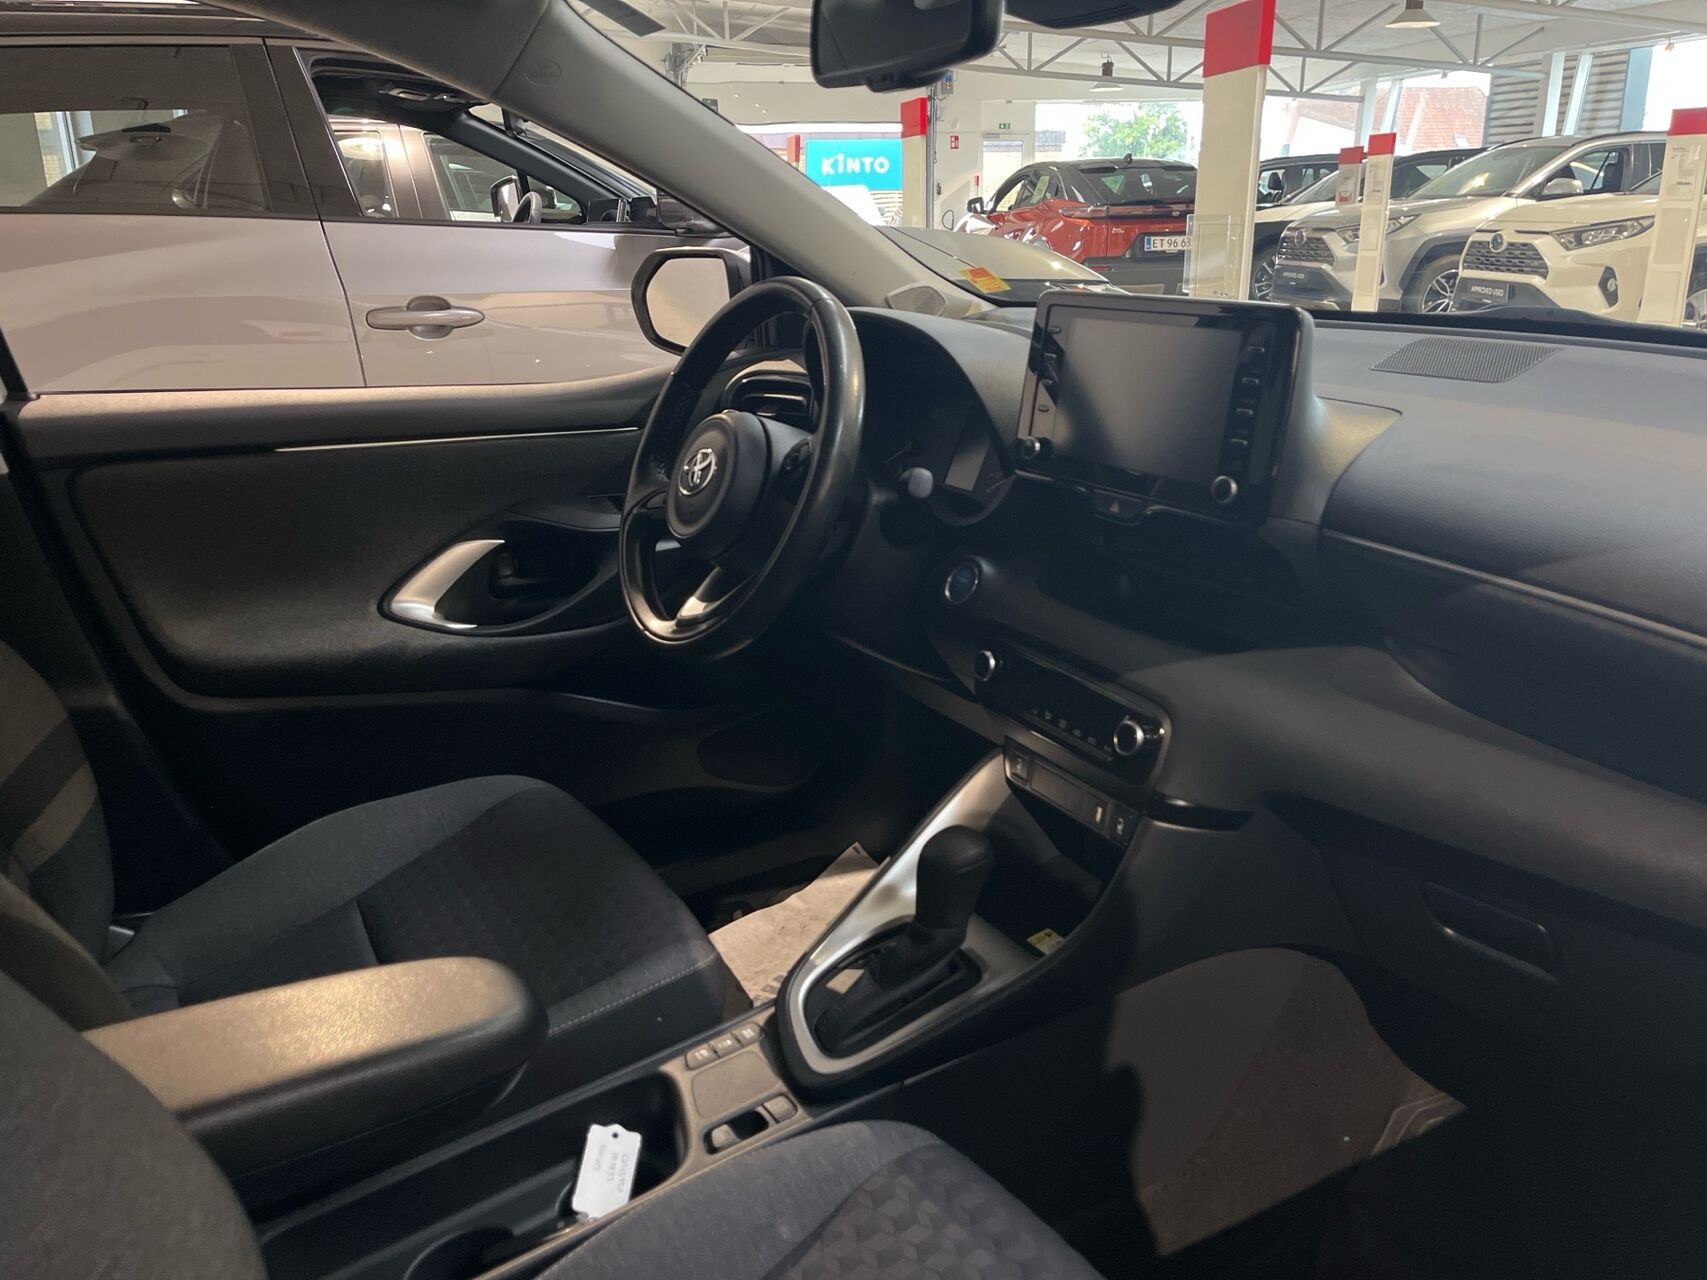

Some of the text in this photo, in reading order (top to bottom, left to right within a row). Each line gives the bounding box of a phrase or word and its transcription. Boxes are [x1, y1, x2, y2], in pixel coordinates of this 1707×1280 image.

[822, 153, 890, 176] KINTO
[1152, 238, 1166, 248] ET
[1167, 238, 1179, 248] 96
